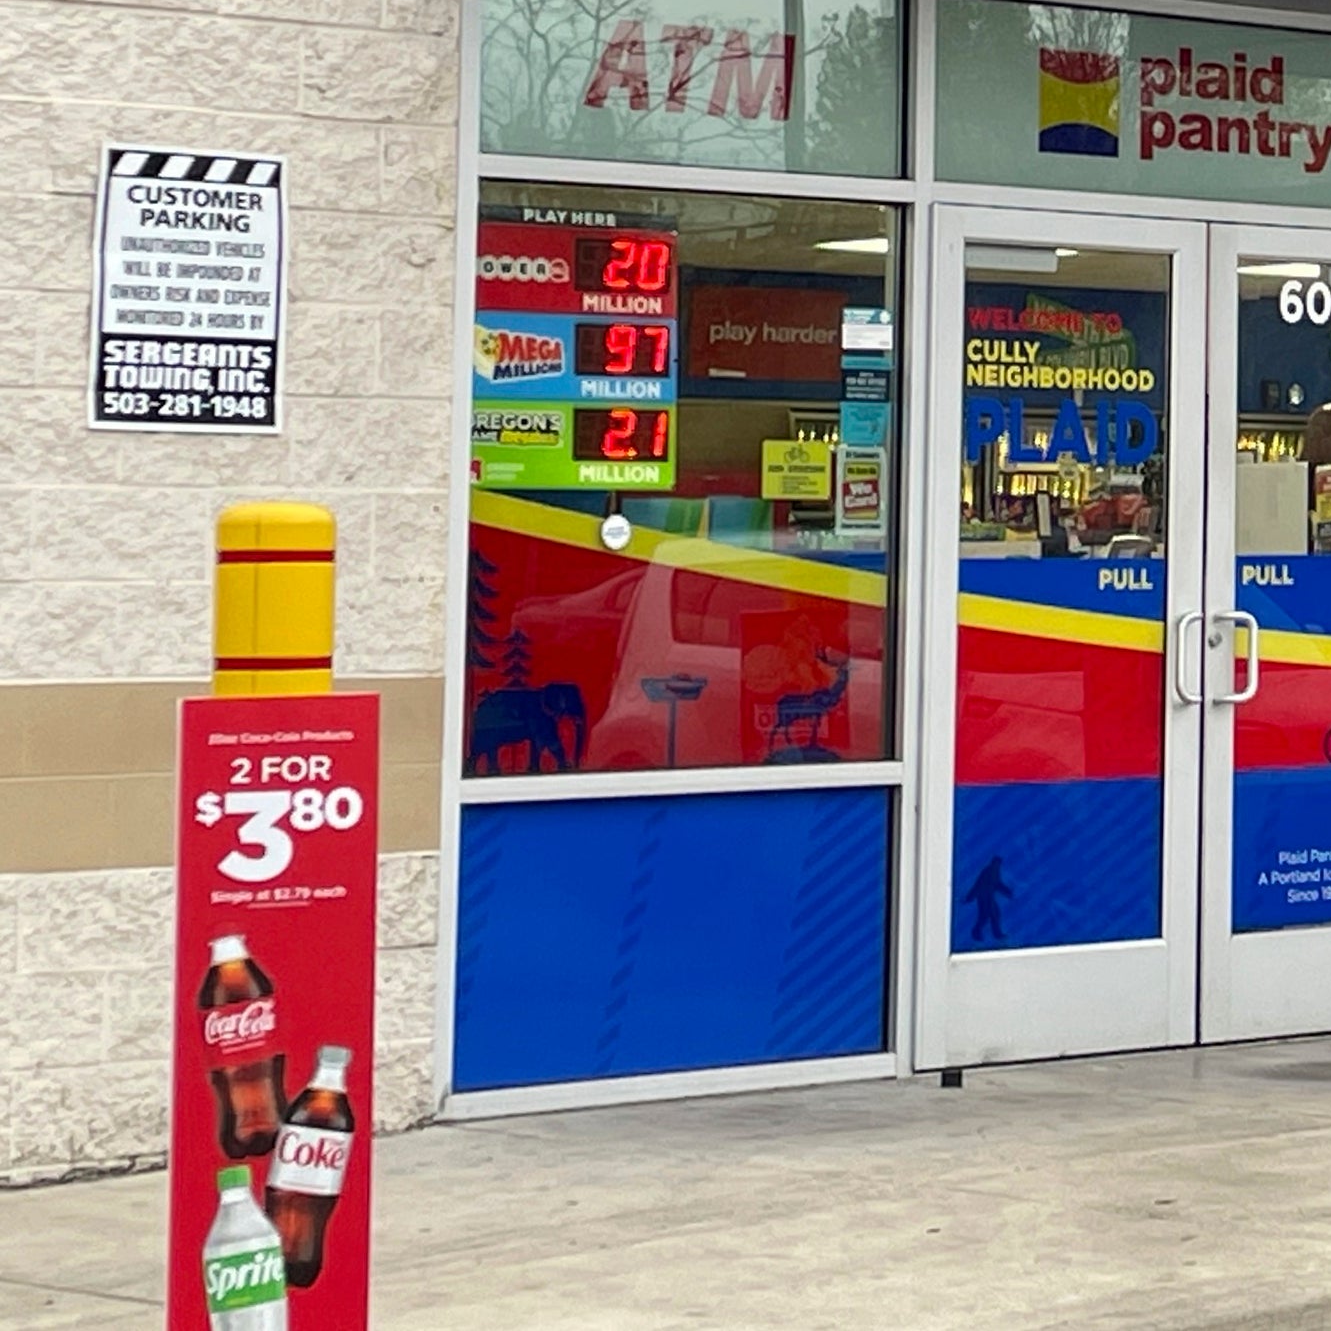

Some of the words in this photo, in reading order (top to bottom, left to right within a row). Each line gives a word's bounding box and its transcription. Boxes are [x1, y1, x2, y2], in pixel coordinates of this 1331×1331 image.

[584, 19, 796, 121] ATM
[1140, 48, 1284, 106] plaid
[127, 185, 263, 212] CUSTOMER
[139, 208, 251, 233] PARKING
[523, 208, 565, 223] PLAY
[571, 210, 616, 226] HERE
[603, 241, 670, 290] 20
[582, 296, 662, 314] MILLION
[709, 320, 757, 345] play
[762, 323, 837, 345] harder
[967, 307, 1084, 333] WELCOME
[1093, 312, 1123, 334] TO
[103, 339, 272, 369] SERGEANTS
[497, 332, 562, 362] MEGA
[605, 324, 668, 373] 97
[967, 339, 1040, 363] CULLY
[103, 365, 214, 395] TOWING,
[217, 369, 271, 393] INC.
[581, 380, 660, 398] MILLION
[967, 364, 1155, 391] NEIGHBORHOOD
[103, 391, 267, 418] 503-281-1948
[965, 396, 1157, 466] PLAID
[579, 465, 659, 483] MILLION
[1098, 568, 1153, 590] PULL
[1242, 565, 1294, 586] PULL
[230, 758, 253, 784] 2
[261, 755, 331, 783] FOR
[1279, 849, 1308, 864] Plaid
[1258, 872, 1268, 885] A
[1271, 869, 1320, 884] Portland
[1287, 889, 1319, 903] Since
[279, 1131, 344, 1170] Coke
[207, 1252, 284, 1301] Sprite
